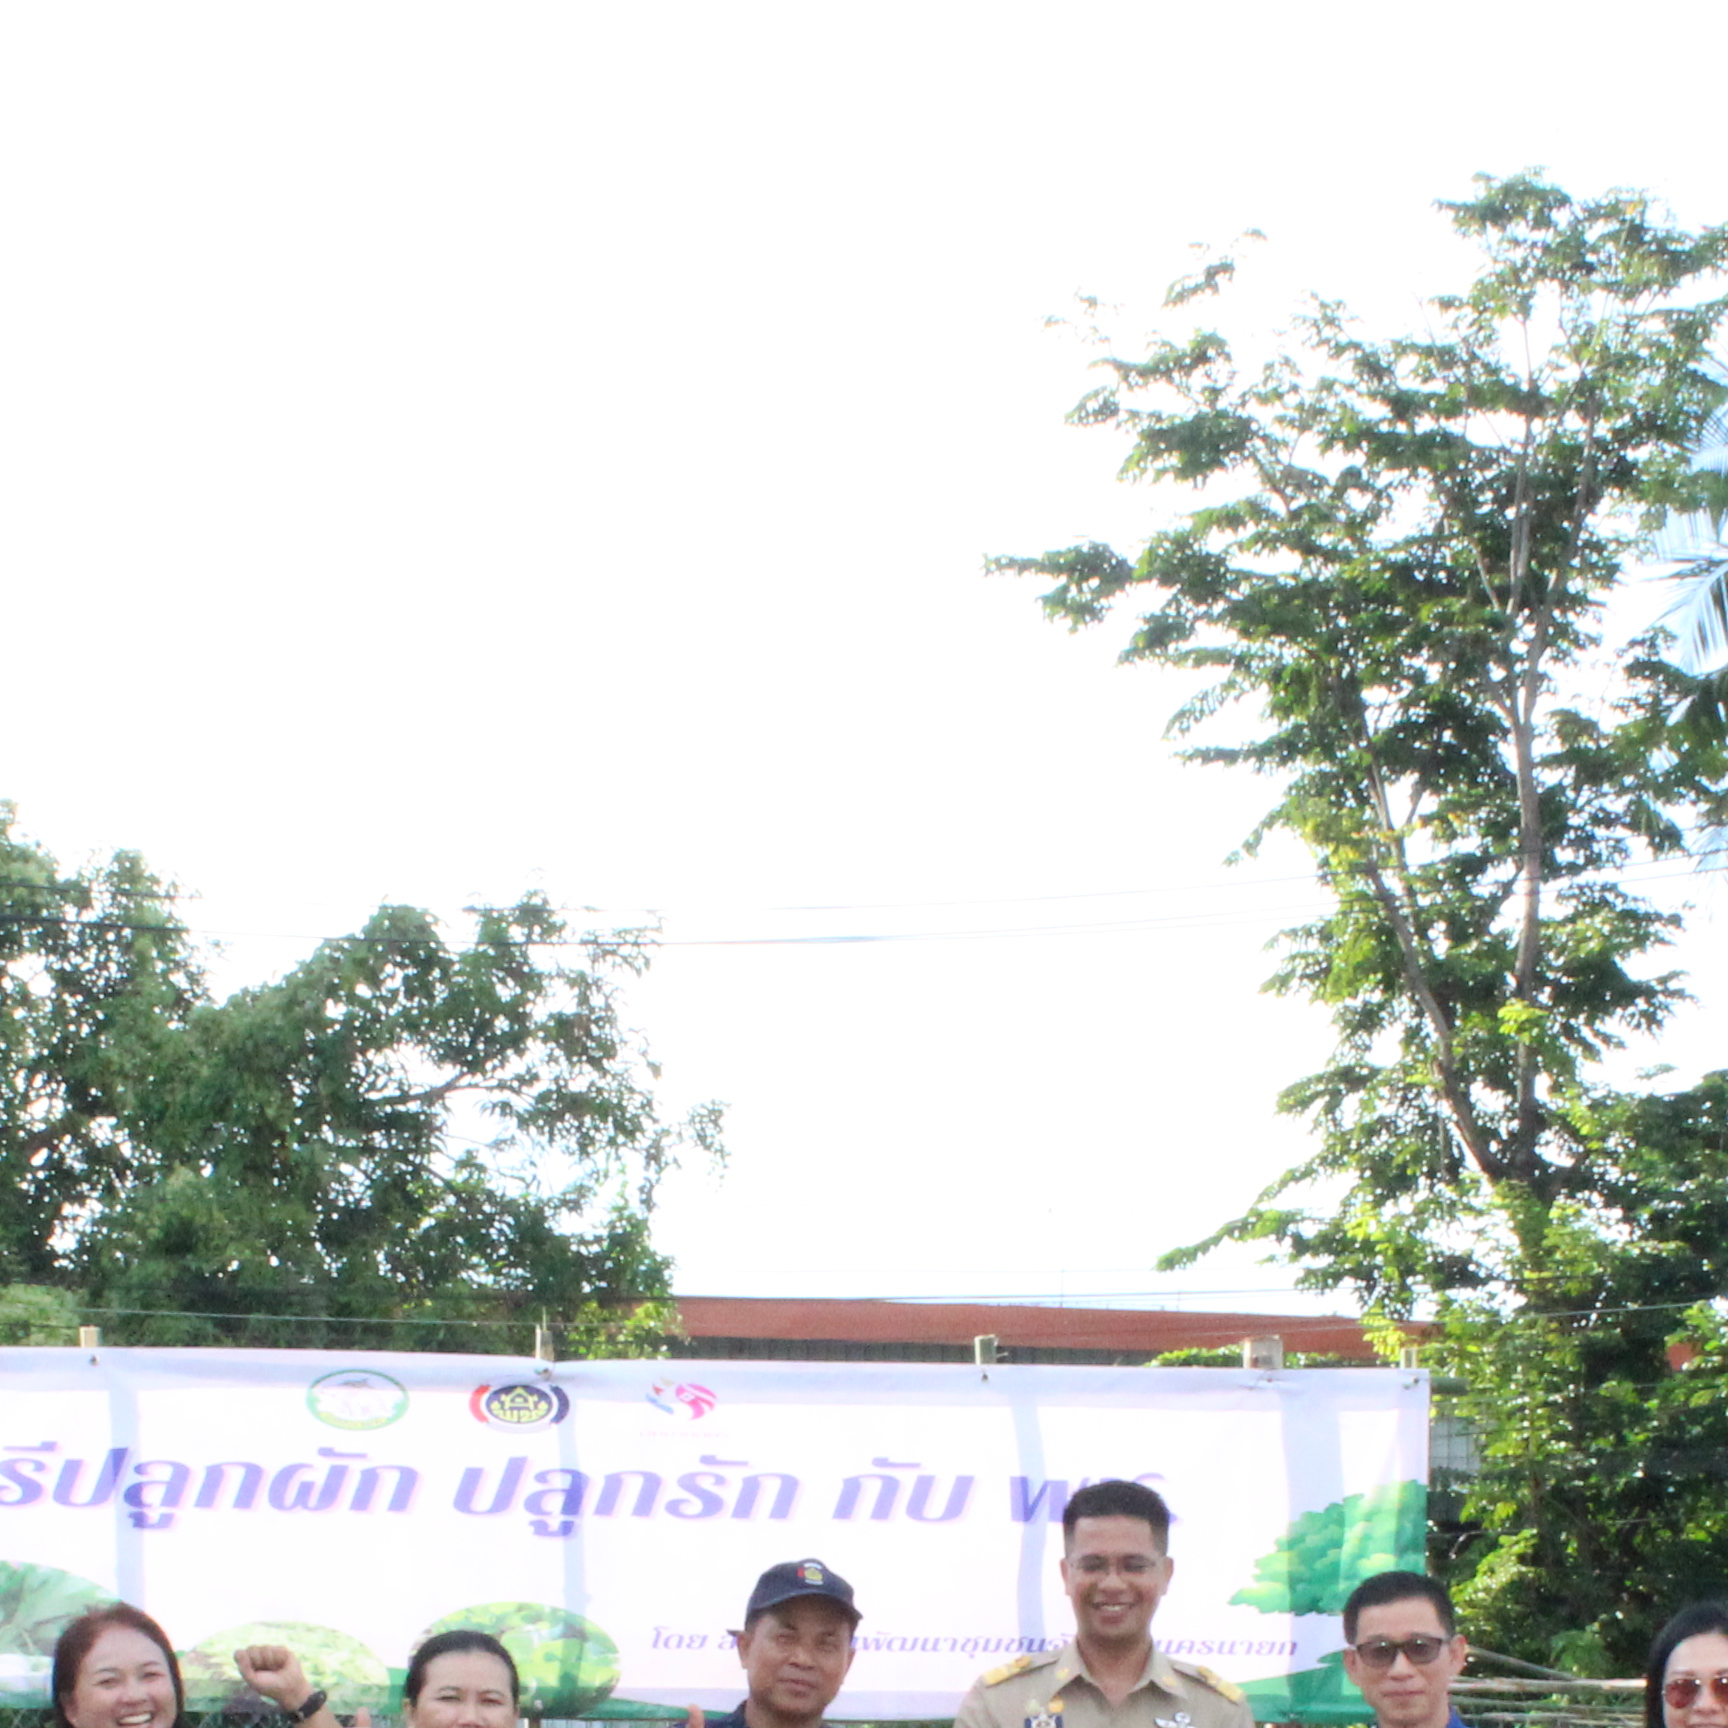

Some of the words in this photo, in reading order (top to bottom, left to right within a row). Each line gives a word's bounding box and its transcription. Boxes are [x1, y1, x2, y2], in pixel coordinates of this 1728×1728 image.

[451, 1454, 802, 1538] ปลูกรัก
[831, 1456, 977, 1523] กับ
[652, 1625, 708, 1650] โดย
